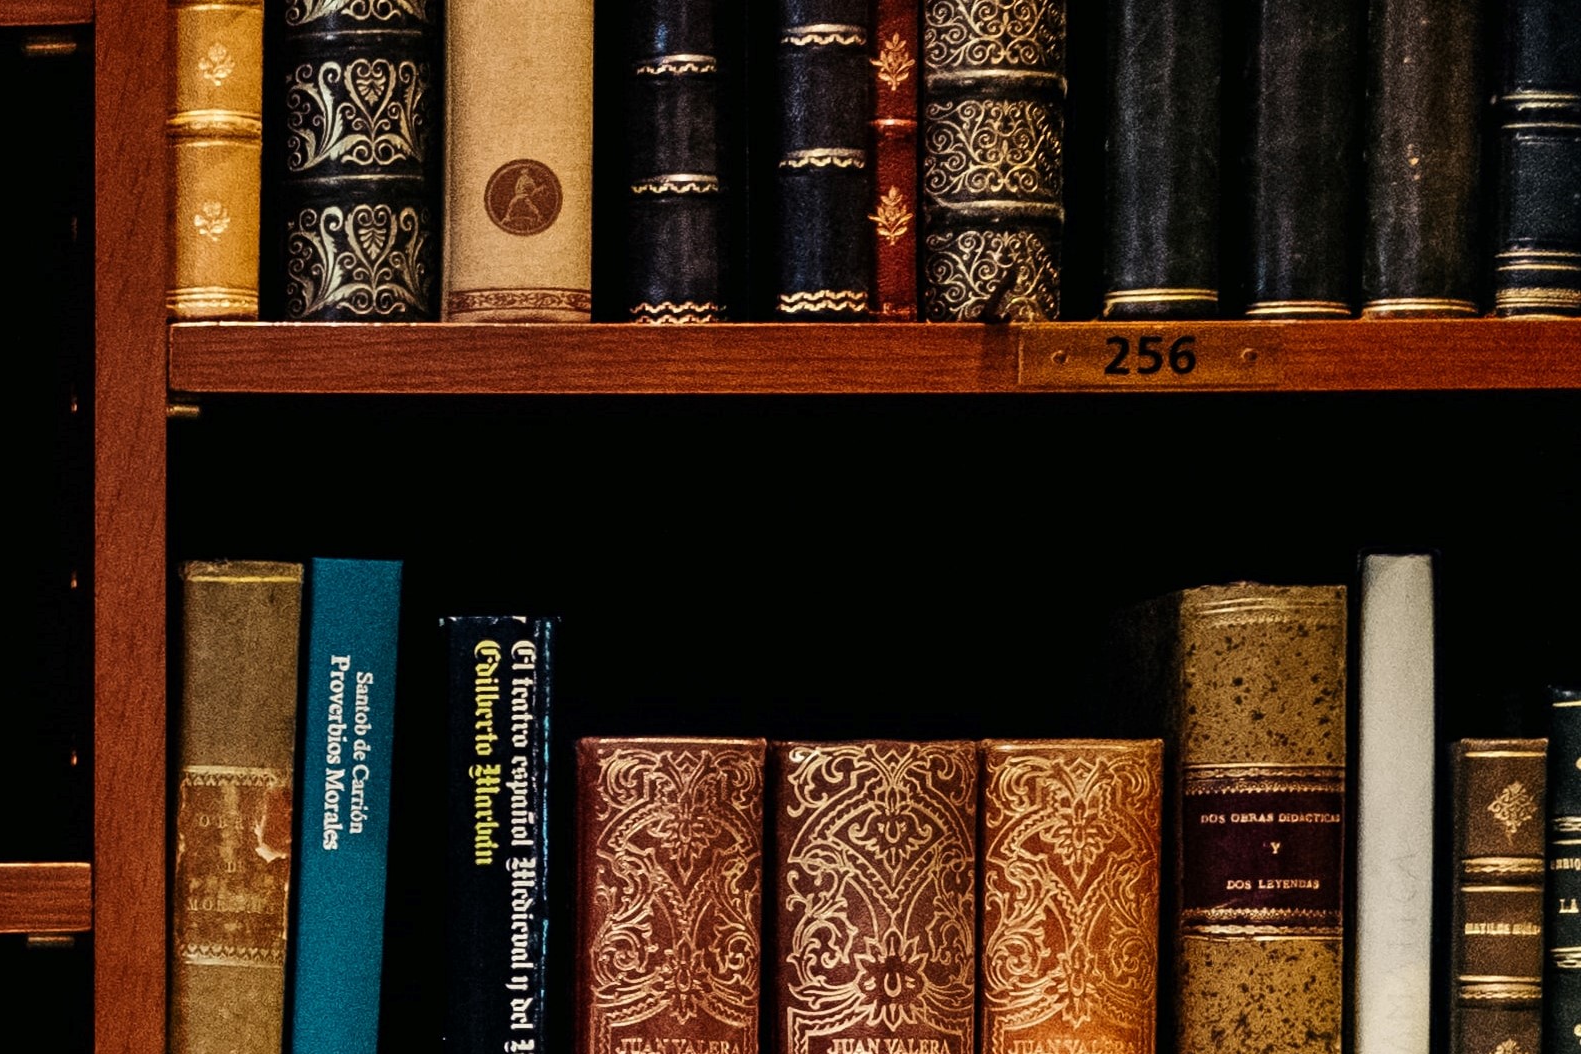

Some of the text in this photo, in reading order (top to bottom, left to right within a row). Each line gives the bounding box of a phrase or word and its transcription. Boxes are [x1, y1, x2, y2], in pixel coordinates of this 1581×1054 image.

[1104, 335, 1198, 376] 256
[322, 654, 351, 851] Proverbios Morales
[349, 672, 374, 834] Santob de Carrión
[474, 638, 501, 756] Edilberto
